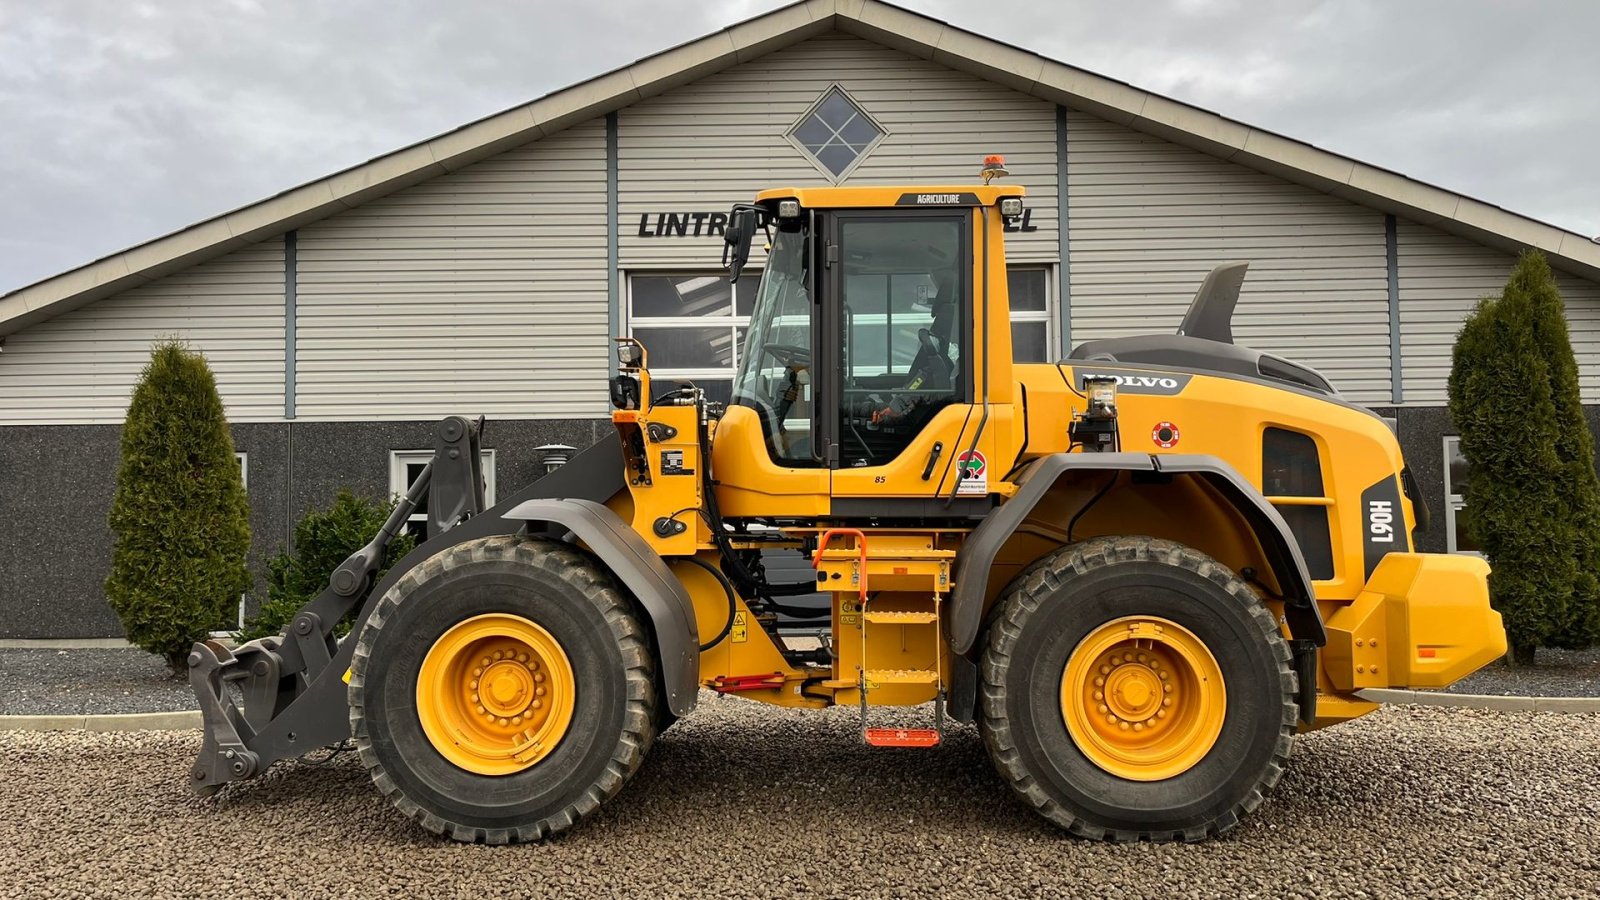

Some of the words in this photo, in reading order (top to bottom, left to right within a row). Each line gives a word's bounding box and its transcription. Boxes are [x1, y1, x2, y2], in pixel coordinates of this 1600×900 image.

[917, 194, 960, 204] AGRICULTURE
[638, 213, 728, 237] LINTR
[874, 476, 886, 484] 85
[1369, 501, 1394, 542] L90H
